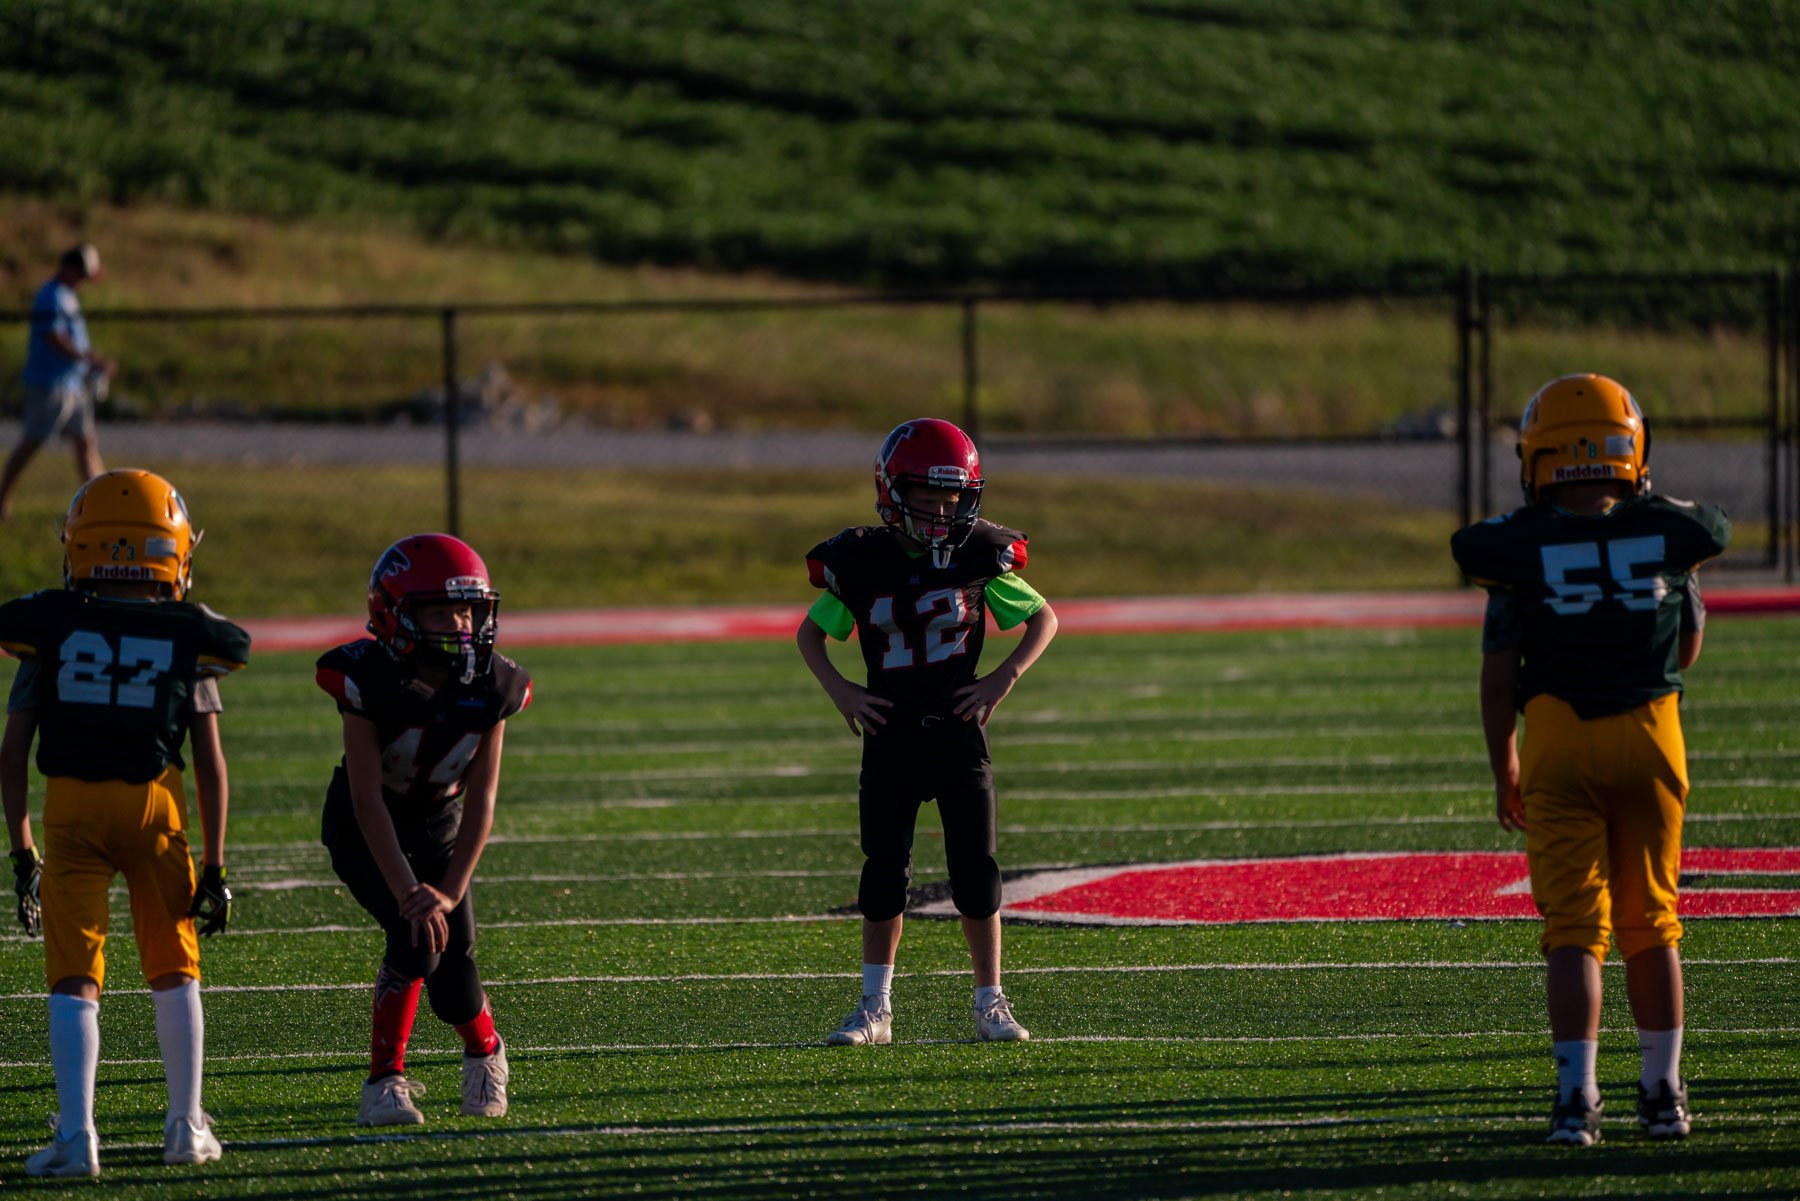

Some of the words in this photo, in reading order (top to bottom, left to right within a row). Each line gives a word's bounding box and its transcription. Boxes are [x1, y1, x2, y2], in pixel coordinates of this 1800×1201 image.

[1554, 464, 1612, 480] Riddell
[93, 566, 150, 579] Riddell
[1539, 534, 1667, 616] 55
[867, 586, 971, 671] 12
[56, 629, 174, 708] 87
[381, 724, 484, 801] 44
